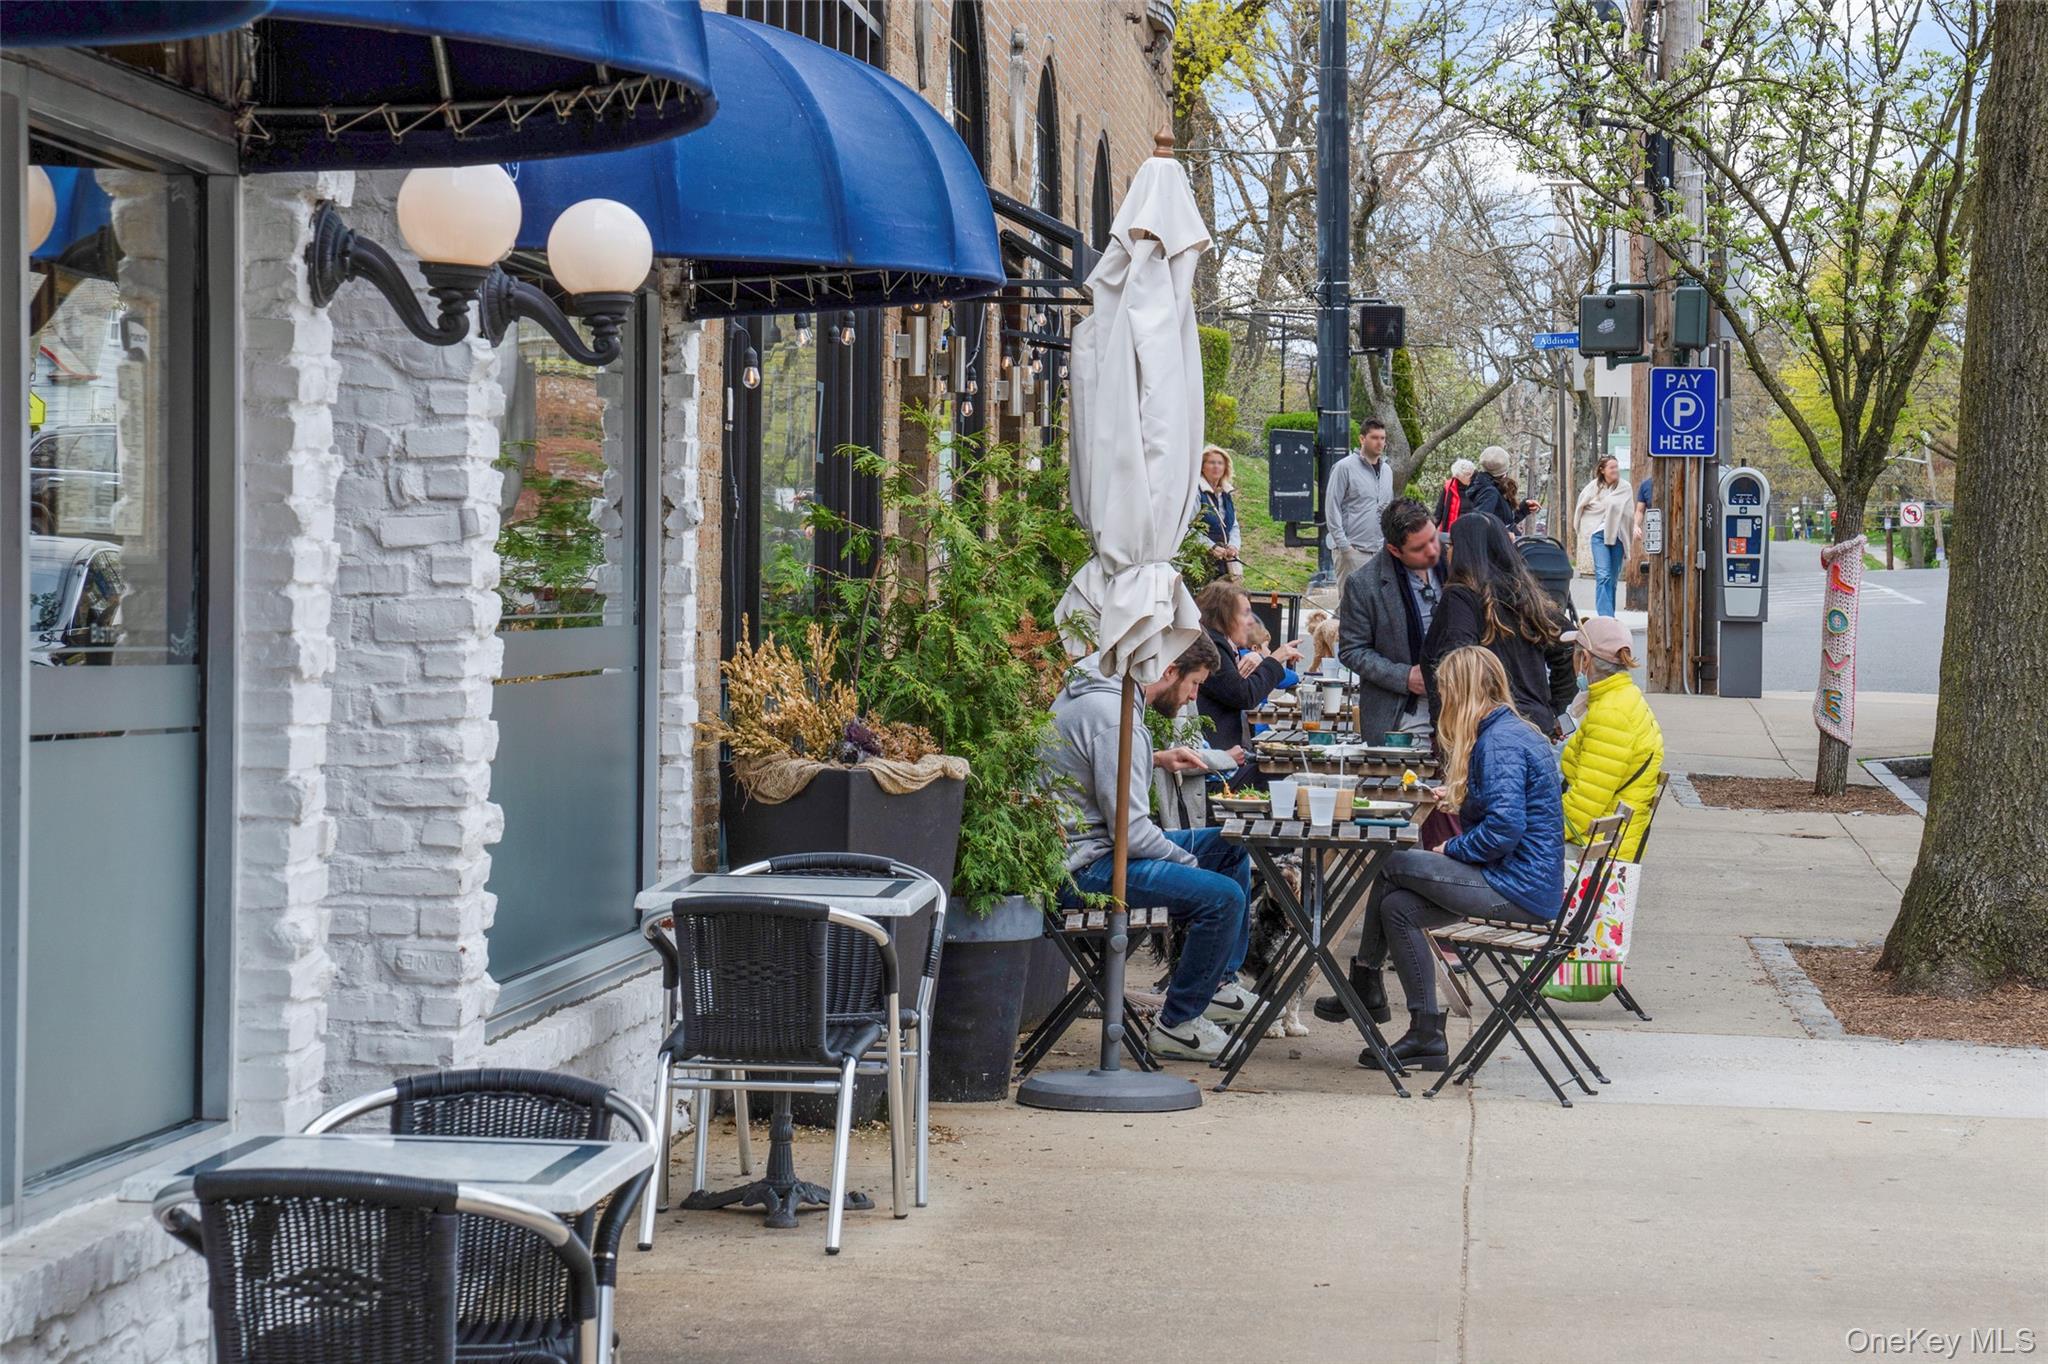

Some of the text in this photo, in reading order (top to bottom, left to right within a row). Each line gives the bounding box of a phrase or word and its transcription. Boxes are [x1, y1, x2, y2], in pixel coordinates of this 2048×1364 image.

[1541, 336, 1575, 345] Addison
[1665, 373, 1702, 389] PAY
[1673, 397, 1697, 427] P
[1659, 435, 1705, 450] HERE
